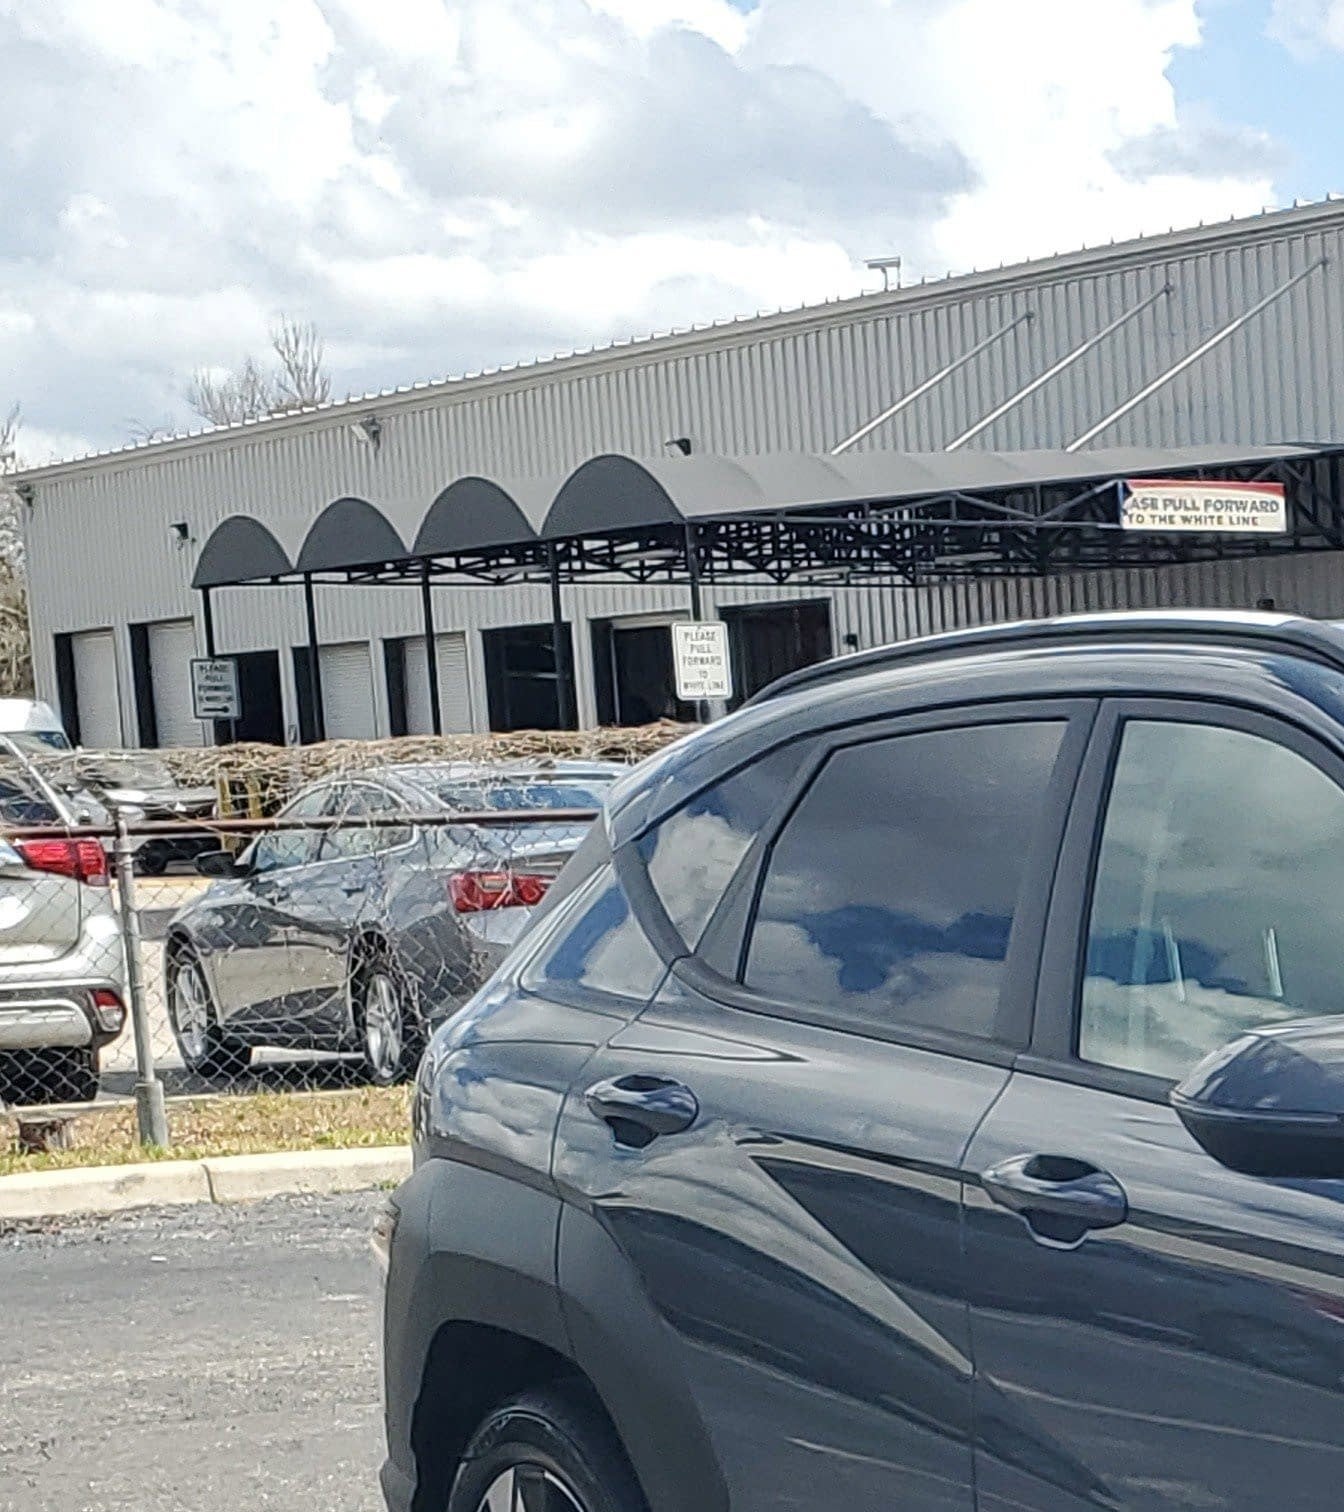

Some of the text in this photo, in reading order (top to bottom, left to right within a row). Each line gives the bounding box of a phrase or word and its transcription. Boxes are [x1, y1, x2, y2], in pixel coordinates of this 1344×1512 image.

[1130, 497, 1280, 513] ASE PULL FORWARD
[1128, 515, 1258, 526] TO THE WHITE LINE
[684, 631, 715, 641] PLEASE
